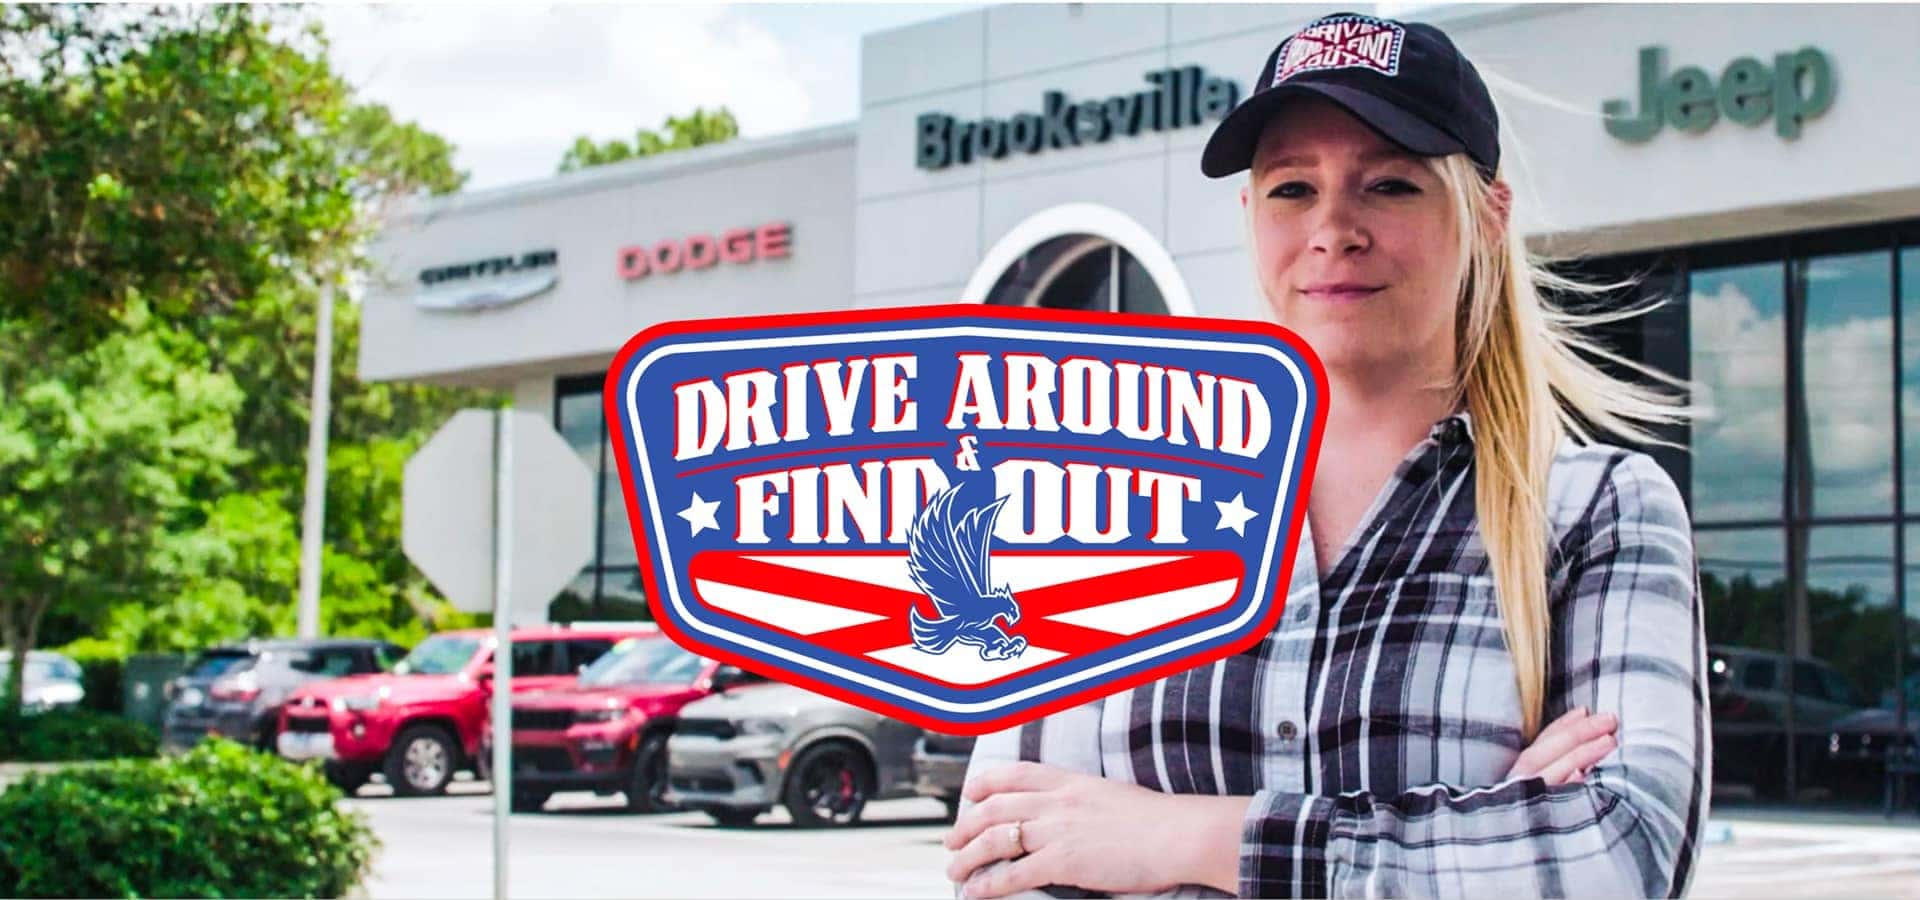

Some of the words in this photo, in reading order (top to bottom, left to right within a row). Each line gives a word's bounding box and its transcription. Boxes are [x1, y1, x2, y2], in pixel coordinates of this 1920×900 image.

[1305, 47, 1359, 66] OUT
[1346, 32, 1393, 68] FIND
[916, 66, 1237, 169] Brooksville
[1603, 46, 1836, 143] Jeep
[617, 222, 794, 281] DODGE
